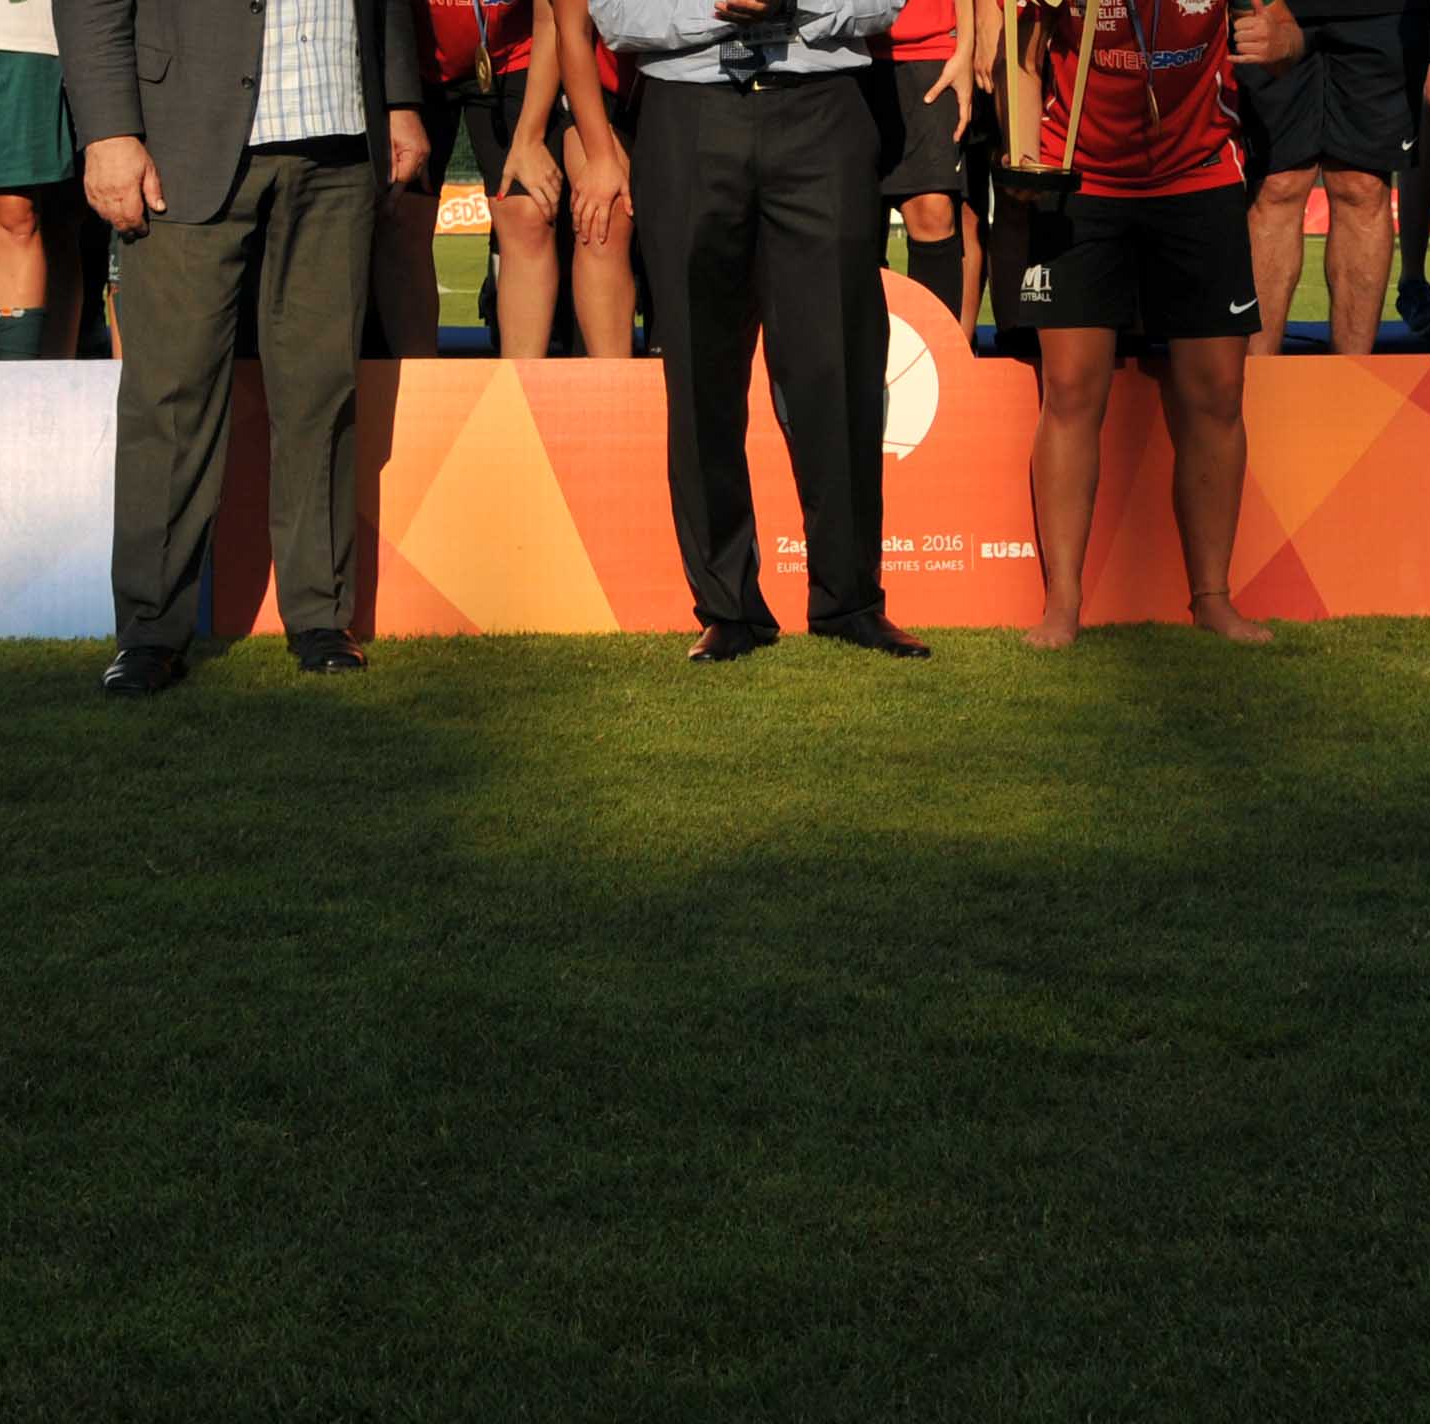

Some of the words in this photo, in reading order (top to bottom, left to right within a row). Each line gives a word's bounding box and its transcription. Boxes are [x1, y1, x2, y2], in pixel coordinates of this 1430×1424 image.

[439, 195, 490, 229] CEDE
[776, 536, 808, 557] Zag
[881, 536, 915, 553] eka
[922, 535, 963, 552] 2016
[981, 541, 1036, 559] EUSA
[925, 559, 964, 572] GAMES
